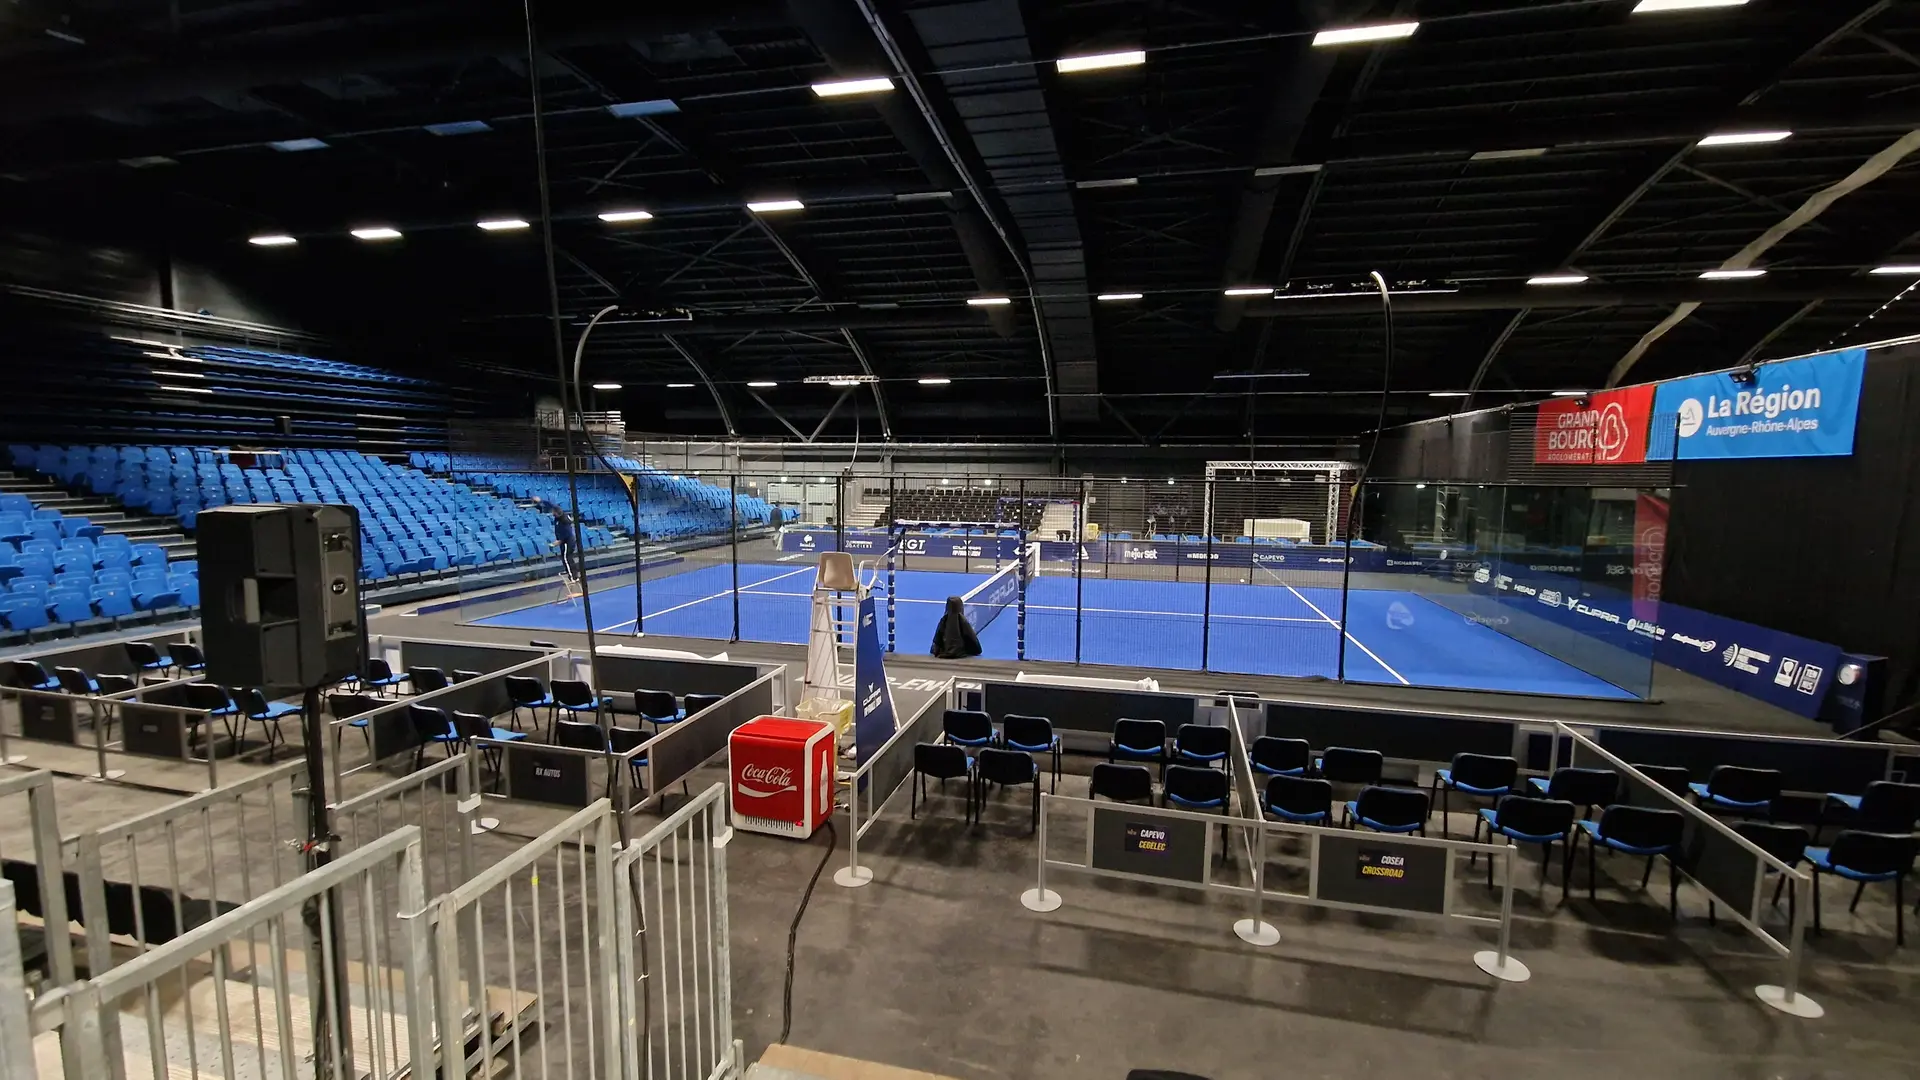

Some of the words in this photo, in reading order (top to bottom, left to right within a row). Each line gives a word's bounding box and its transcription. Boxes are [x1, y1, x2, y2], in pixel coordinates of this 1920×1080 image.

[1707, 394, 1731, 418] La
[1735, 384, 1821, 418] Région
[1557, 410, 1599, 428] GRAND
[1706, 417, 1819, 437] Auvergne-Rhône-Alpes
[1548, 429, 1601, 450] BOURG
[1513, 584, 1537, 597] HEAD
[1576, 604, 1620, 624] CUPRA
[543, 768, 561, 778] AUTOS
[741, 763, 794, 787] Coca-Cola
[1140, 829, 1165, 840] CAPEVO
[1138, 840, 1166, 851] CEGELEC
[1381, 855, 1404, 866] COSEA
[1362, 865, 1404, 878] CROSSROAD
